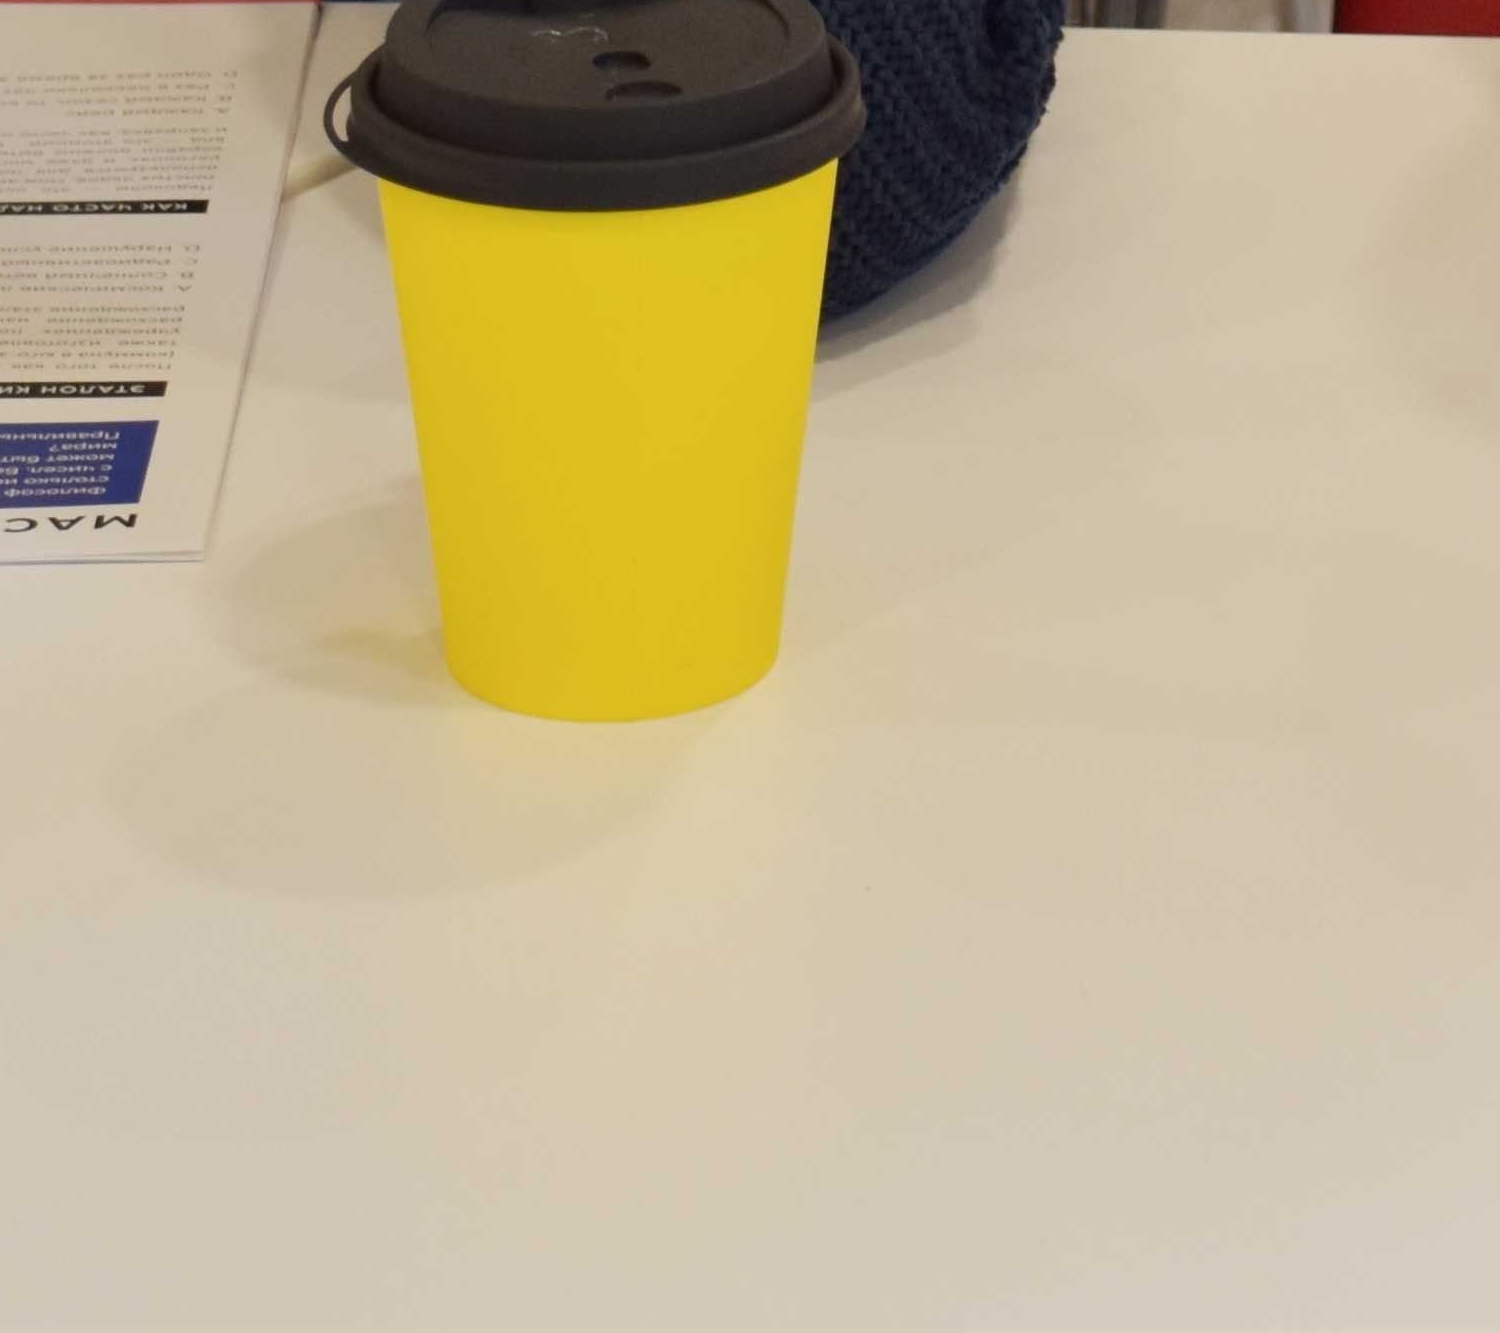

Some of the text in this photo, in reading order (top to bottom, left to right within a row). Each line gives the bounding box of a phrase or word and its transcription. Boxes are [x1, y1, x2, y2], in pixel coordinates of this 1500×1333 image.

[51, 201, 133, 211] ЧАСТО
[141, 201, 187, 210] КАК
[39, 384, 144, 394] ЭТАЛОН
[47, 441, 117, 452] мира?
[46, 453, 114, 461] может
[25, 464, 95, 472] чисел.
[2, 486, 105, 498] Философ
